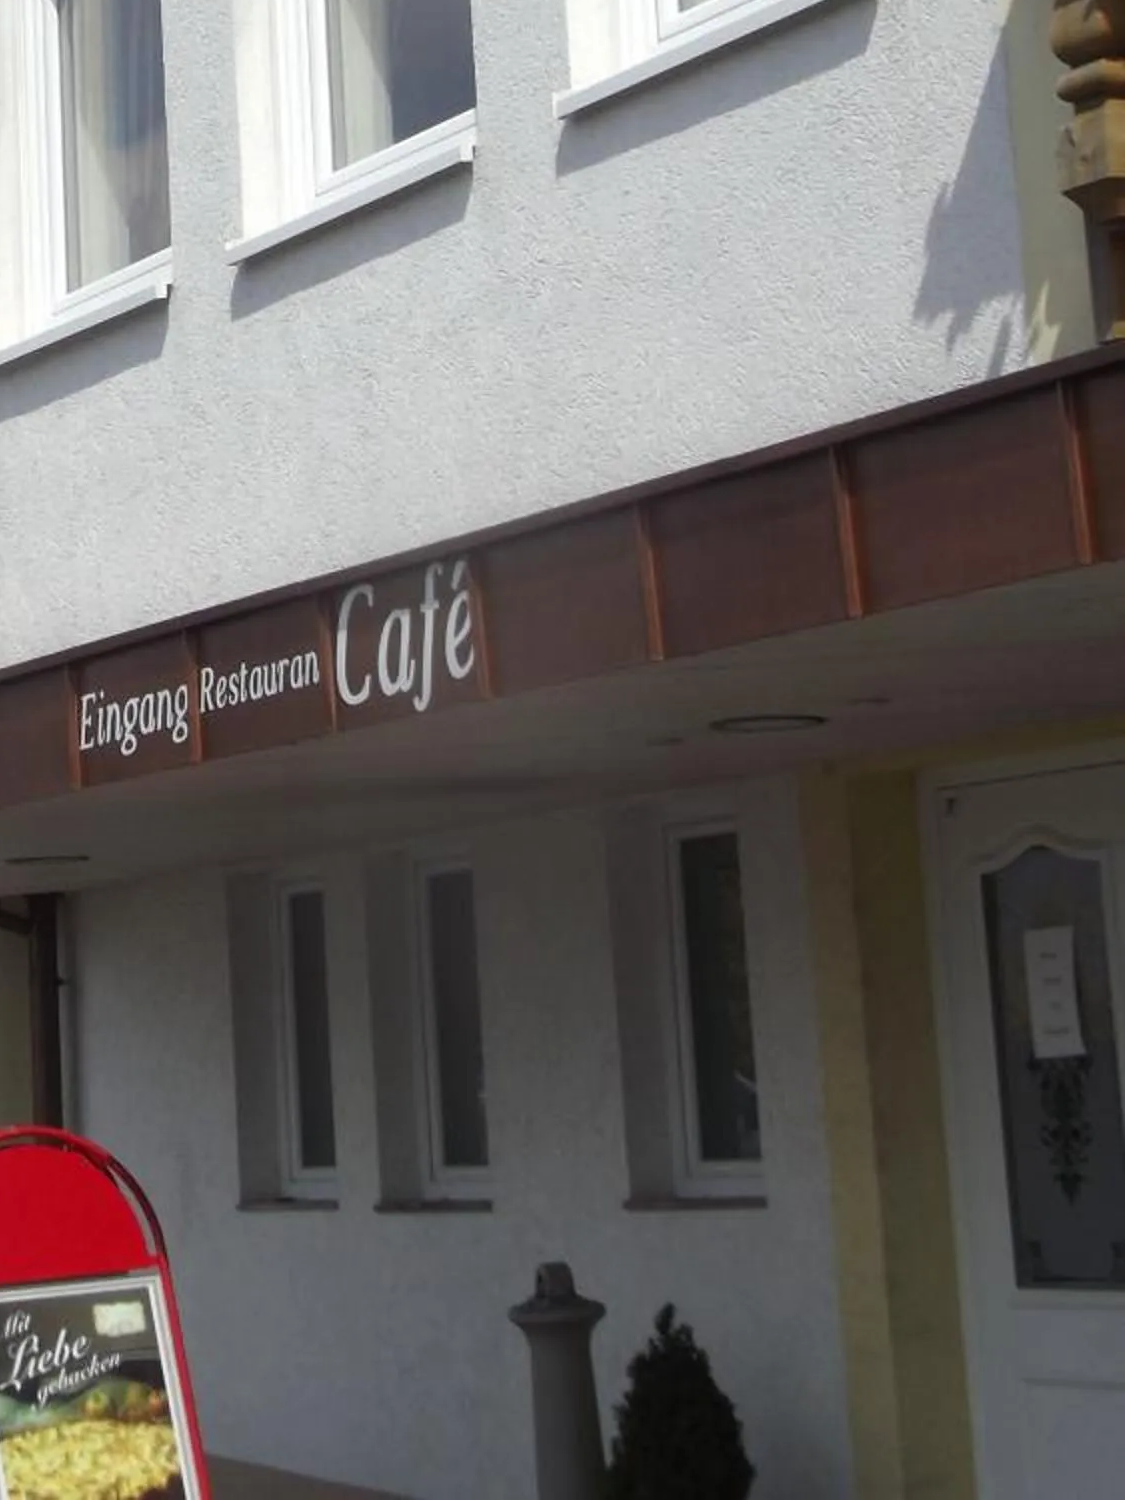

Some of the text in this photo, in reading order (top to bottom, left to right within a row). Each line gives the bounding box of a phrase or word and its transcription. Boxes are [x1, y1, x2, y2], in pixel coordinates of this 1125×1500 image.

[78, 559, 475, 756] Eingang Restauran Café
[31, 1353, 122, 1411] gebacken
